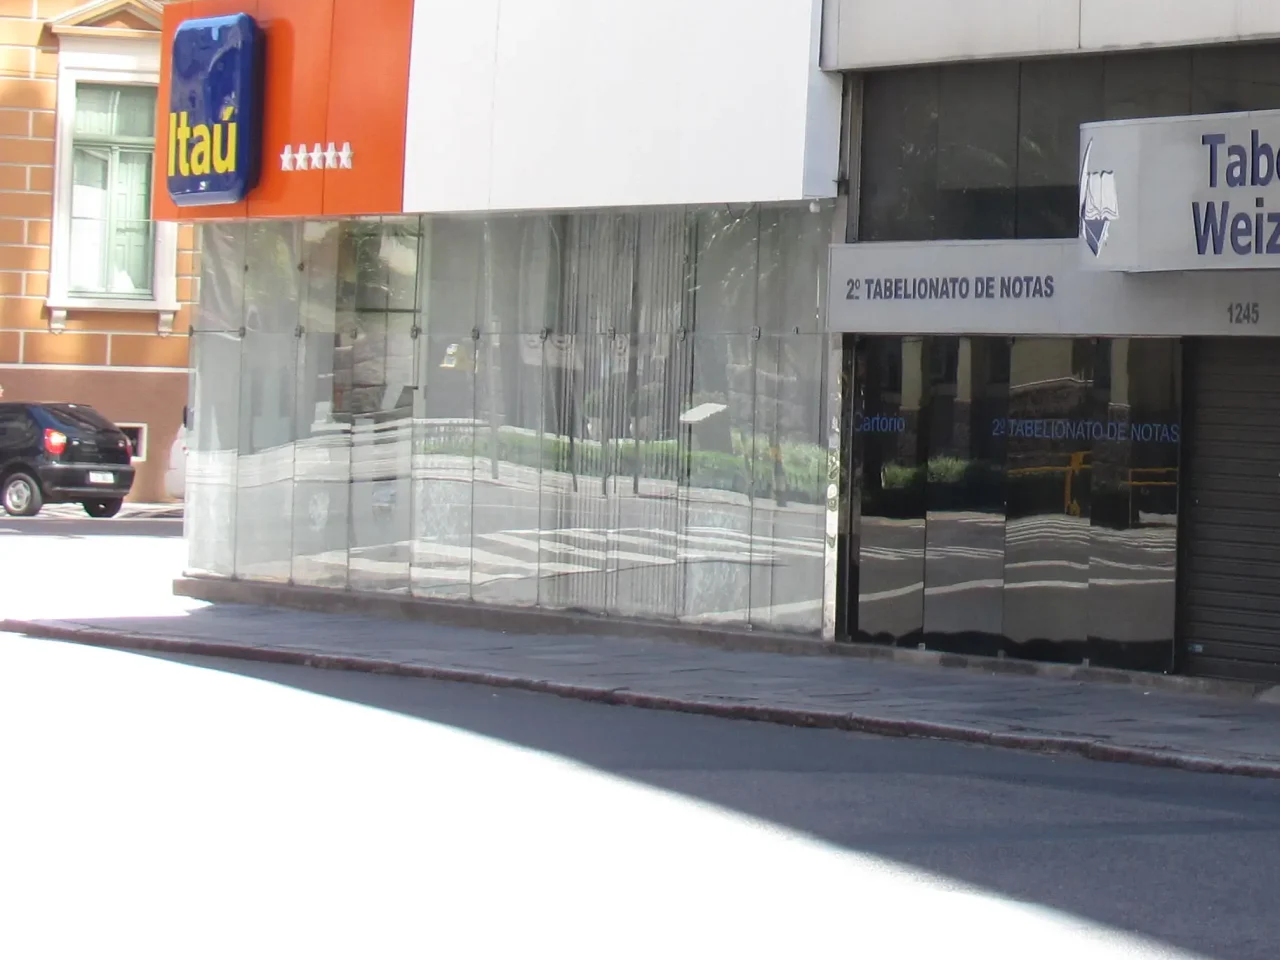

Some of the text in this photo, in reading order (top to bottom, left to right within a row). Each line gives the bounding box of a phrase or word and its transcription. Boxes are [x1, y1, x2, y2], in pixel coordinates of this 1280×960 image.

[168, 106, 237, 177] Itaú
[864, 276, 969, 300] TABELIONATO
[974, 277, 994, 299] DE
[1000, 275, 1054, 299] NOTAS
[1227, 301, 1260, 325] 1245
[854, 411, 906, 433] Cartório
[1008, 419, 1103, 440] TABELIONATO
[1107, 421, 1126, 440] DE
[1131, 423, 1180, 443] NOTAS
